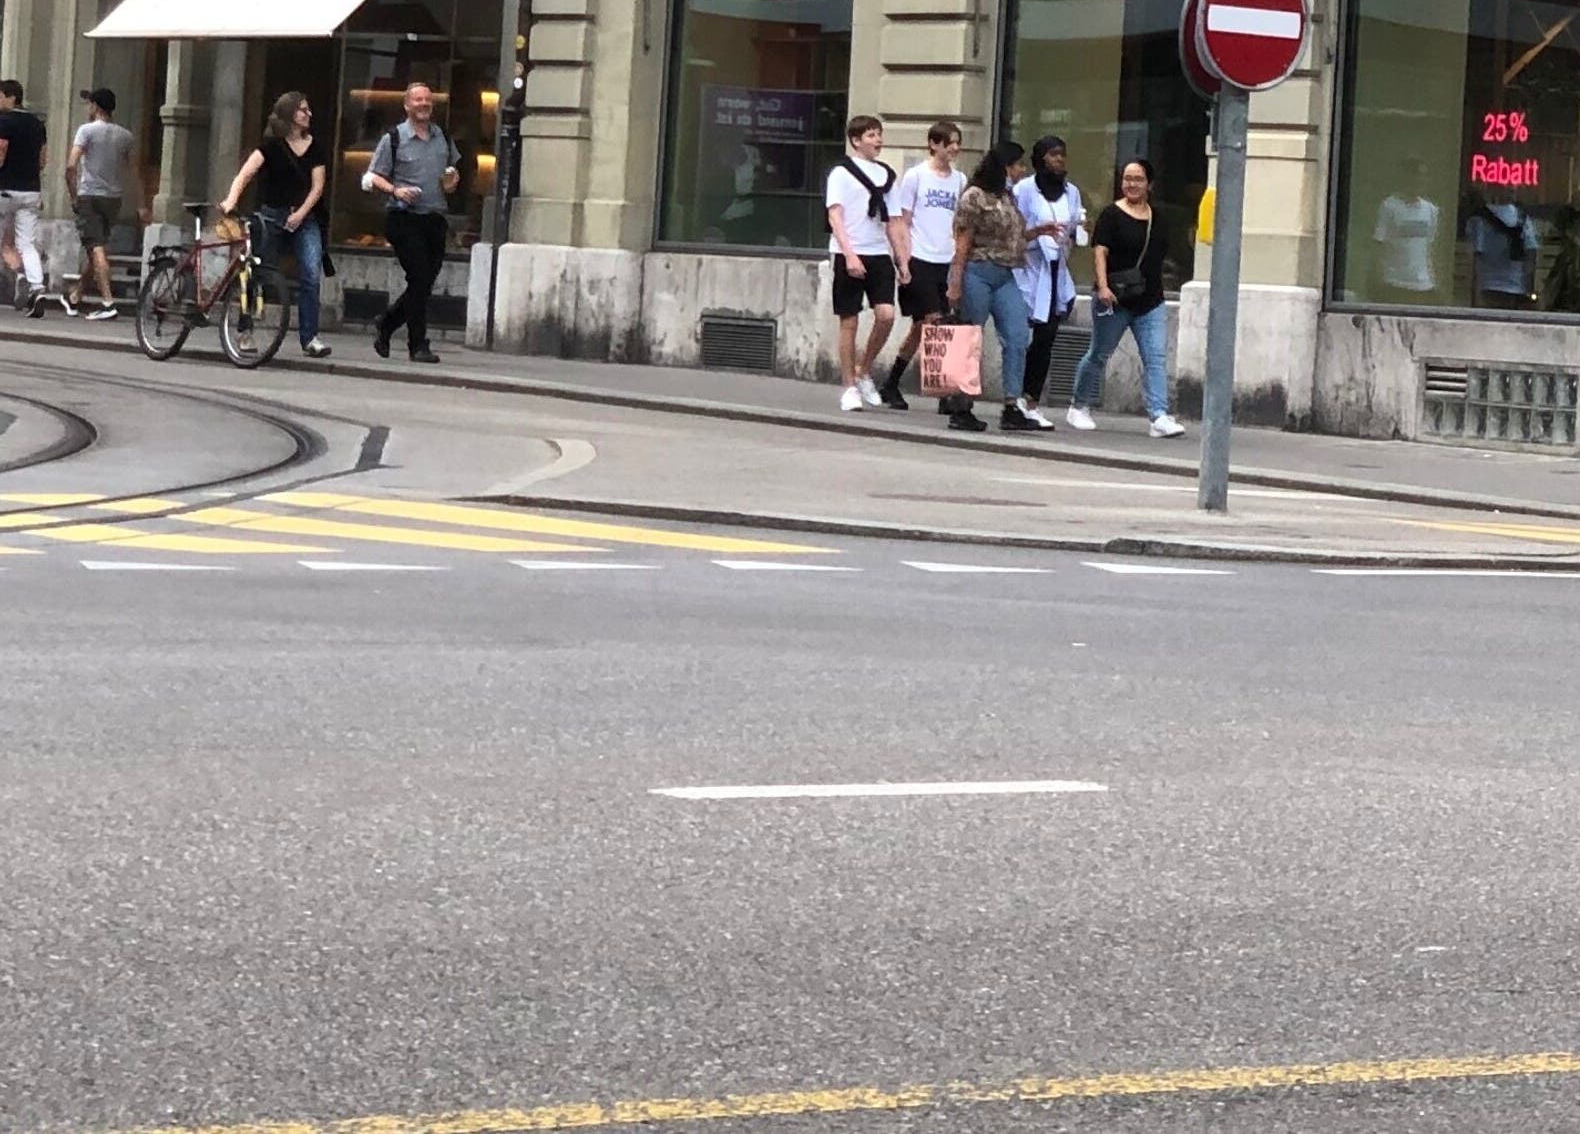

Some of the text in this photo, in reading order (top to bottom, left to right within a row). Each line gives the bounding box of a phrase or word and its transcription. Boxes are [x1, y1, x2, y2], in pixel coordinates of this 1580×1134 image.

[1483, 112, 1528, 142] 25%
[1472, 154, 1539, 186] Rabatt
[924, 327, 955, 342] SHOW
[924, 343, 946, 357] WHO
[924, 358, 942, 373] YOU
